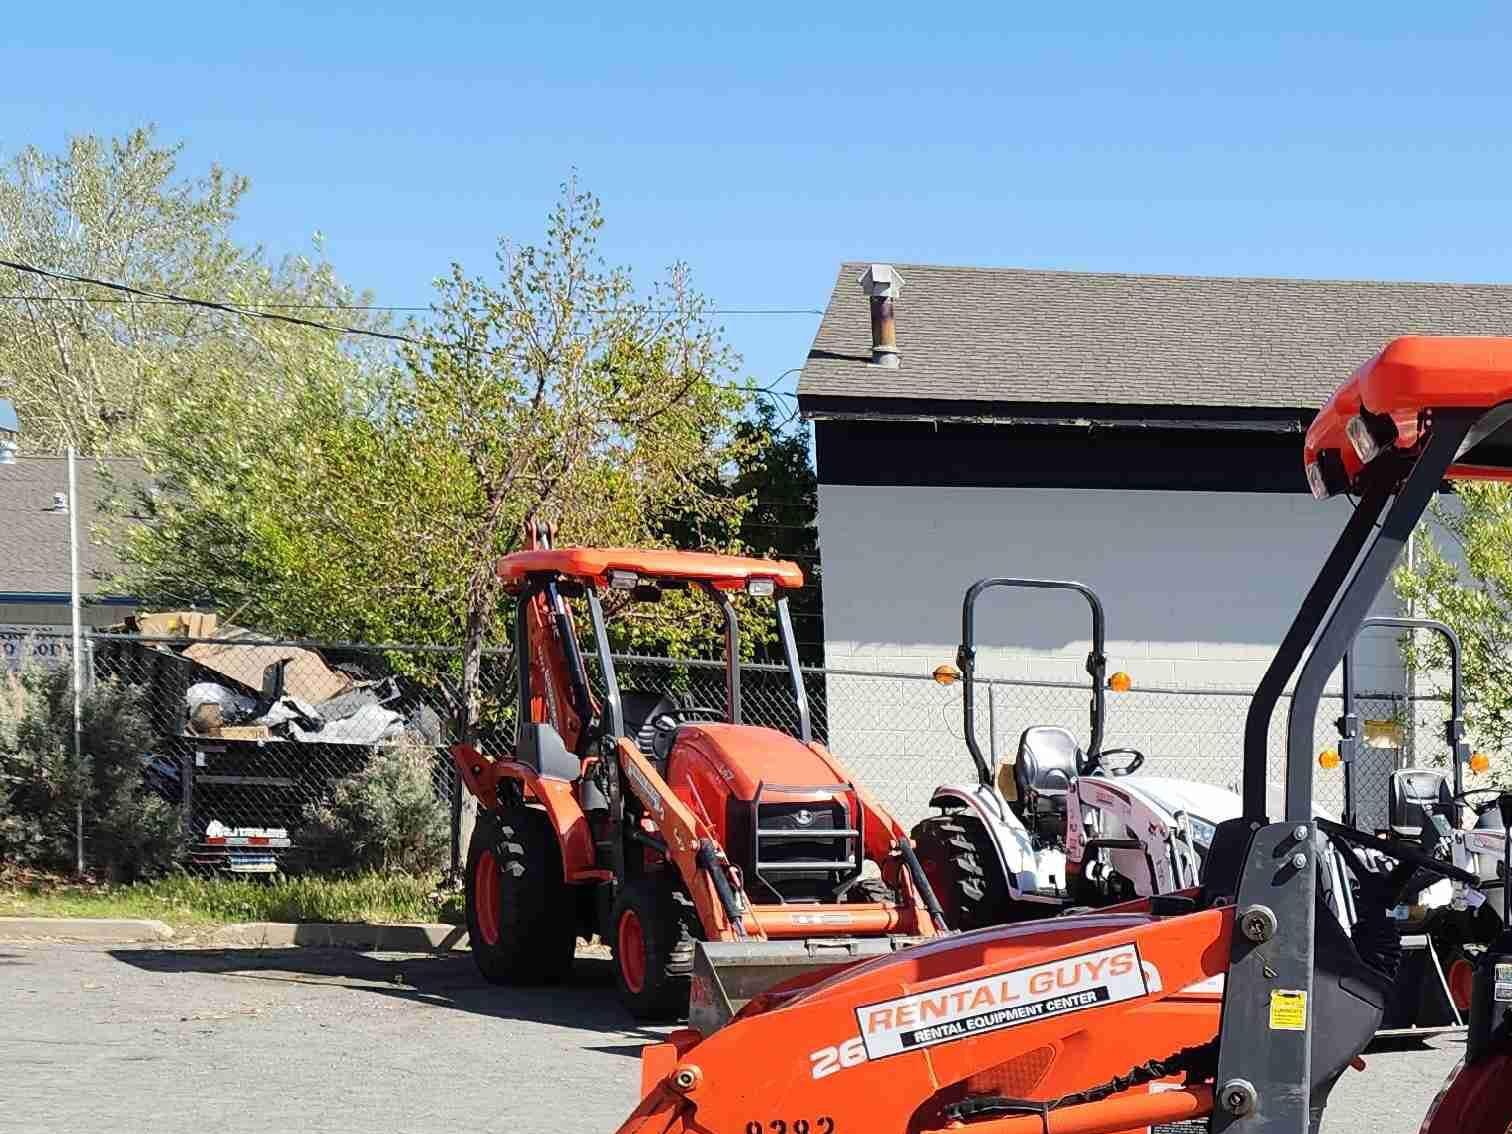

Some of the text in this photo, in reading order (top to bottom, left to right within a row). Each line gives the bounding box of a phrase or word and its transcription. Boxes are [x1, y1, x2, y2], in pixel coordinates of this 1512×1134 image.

[866, 951, 1135, 1035] RENTAL GUYS
[914, 991, 1097, 1044] RENTAL EQUIPMENT CENTER
[809, 1036, 866, 1081] 26
